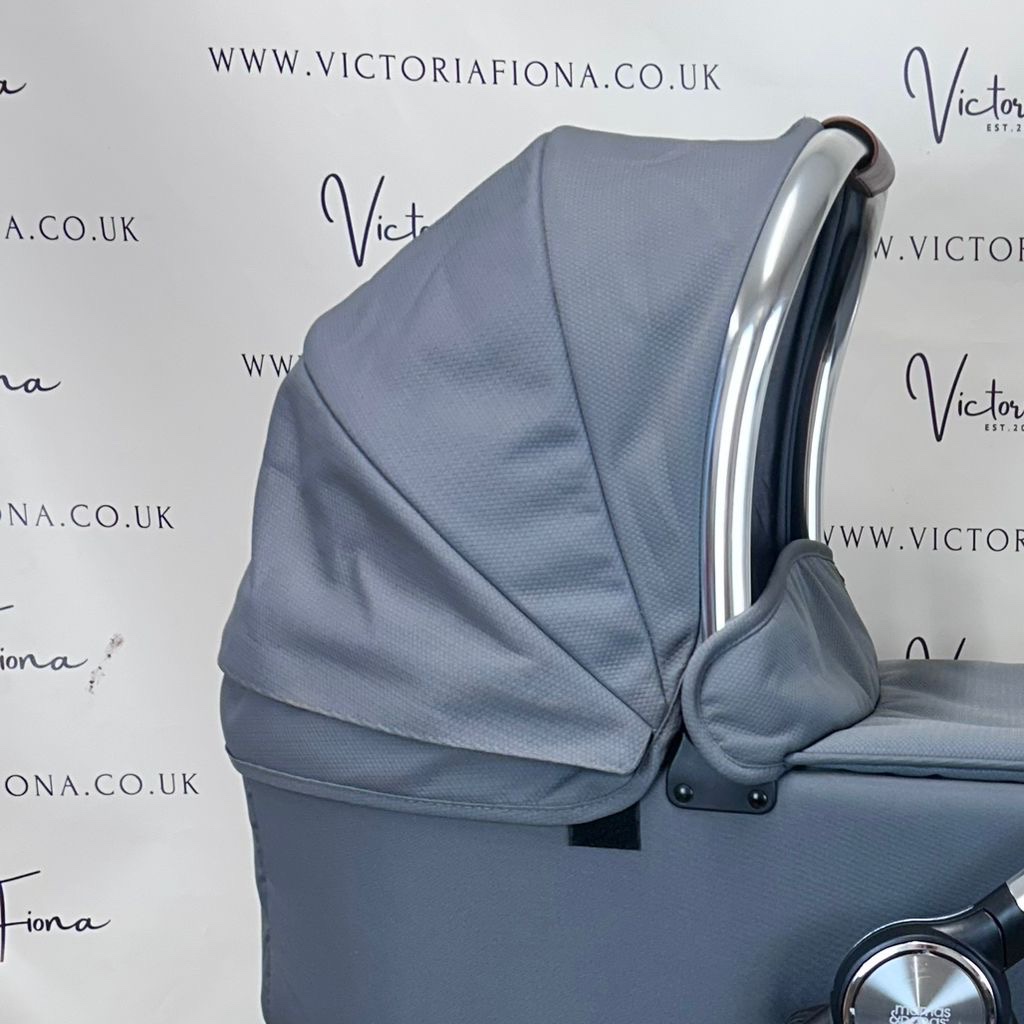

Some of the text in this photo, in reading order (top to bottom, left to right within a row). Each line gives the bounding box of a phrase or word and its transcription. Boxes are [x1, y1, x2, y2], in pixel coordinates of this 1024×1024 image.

[208, 47, 721, 91] WWW.VICTORIAFIONA.CO.UK
[321, 173, 429, 267] Vict
[0, 503, 175, 530] NA.CO.UK
